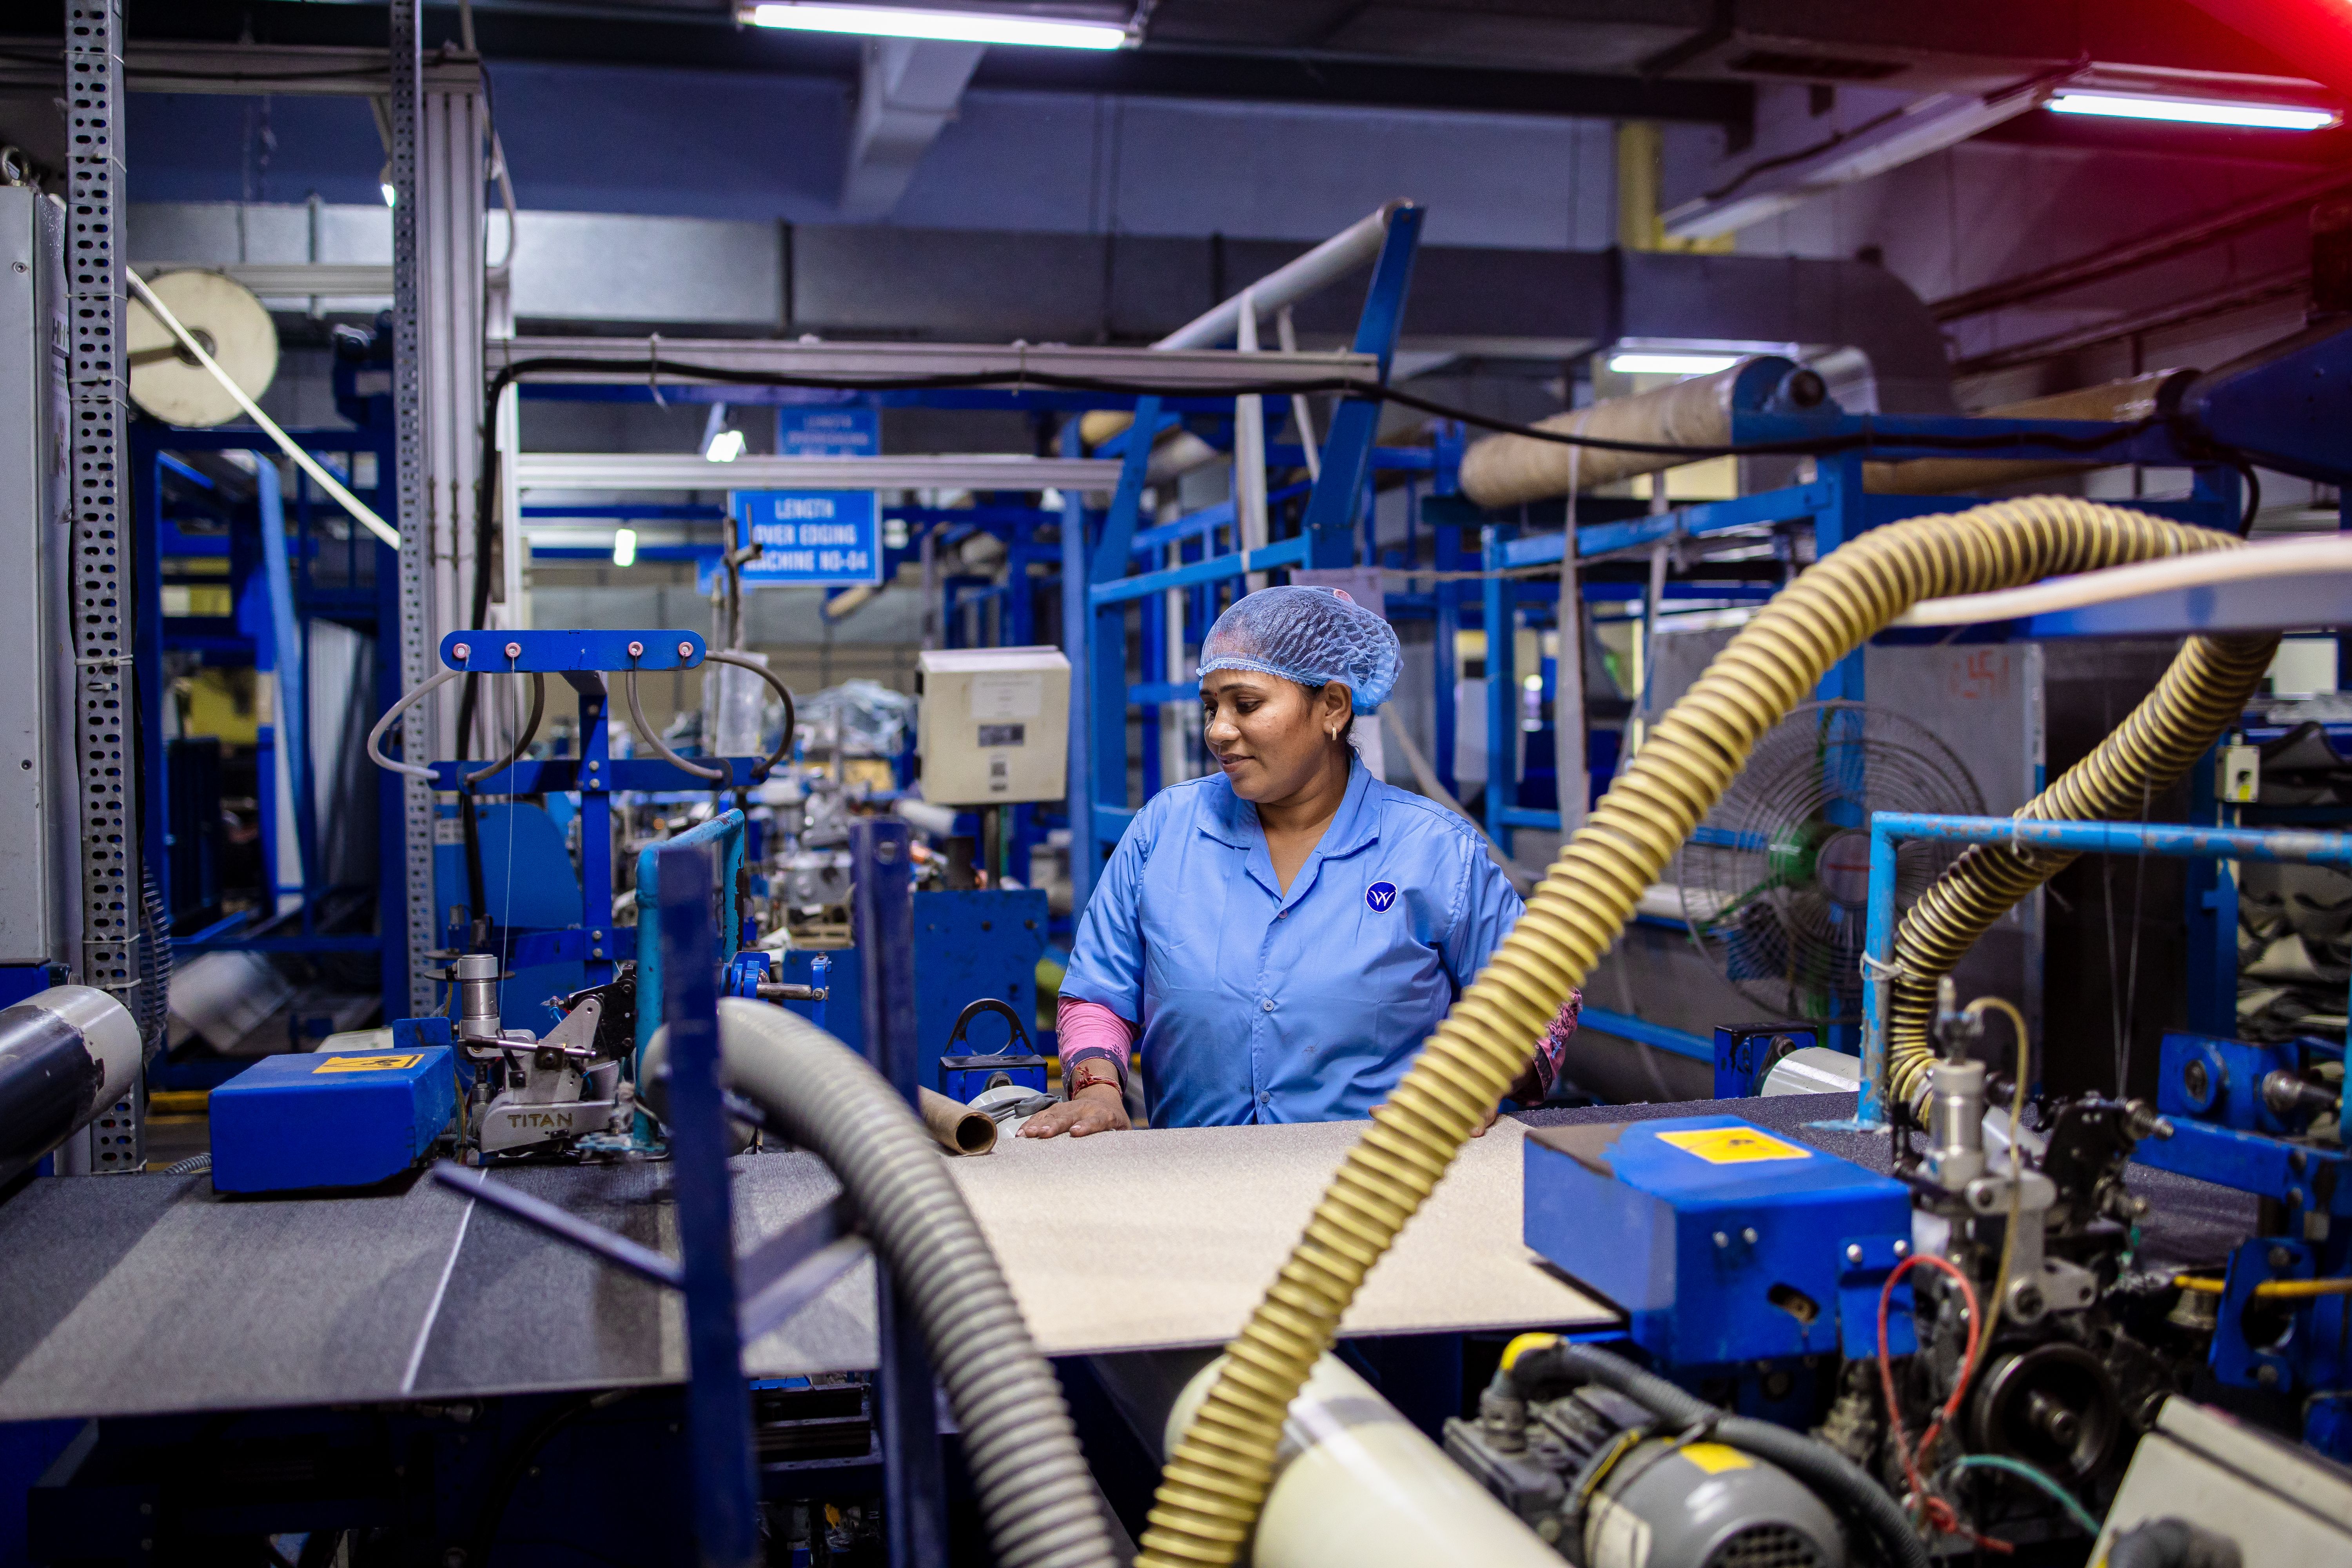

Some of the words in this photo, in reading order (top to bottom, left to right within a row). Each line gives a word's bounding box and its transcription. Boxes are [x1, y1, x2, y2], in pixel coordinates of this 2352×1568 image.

[775, 498, 835, 519] LENGTH
[753, 524, 795, 545] OVER
[799, 524, 857, 545] EDGING
[507, 1112, 573, 1128] TITAN
